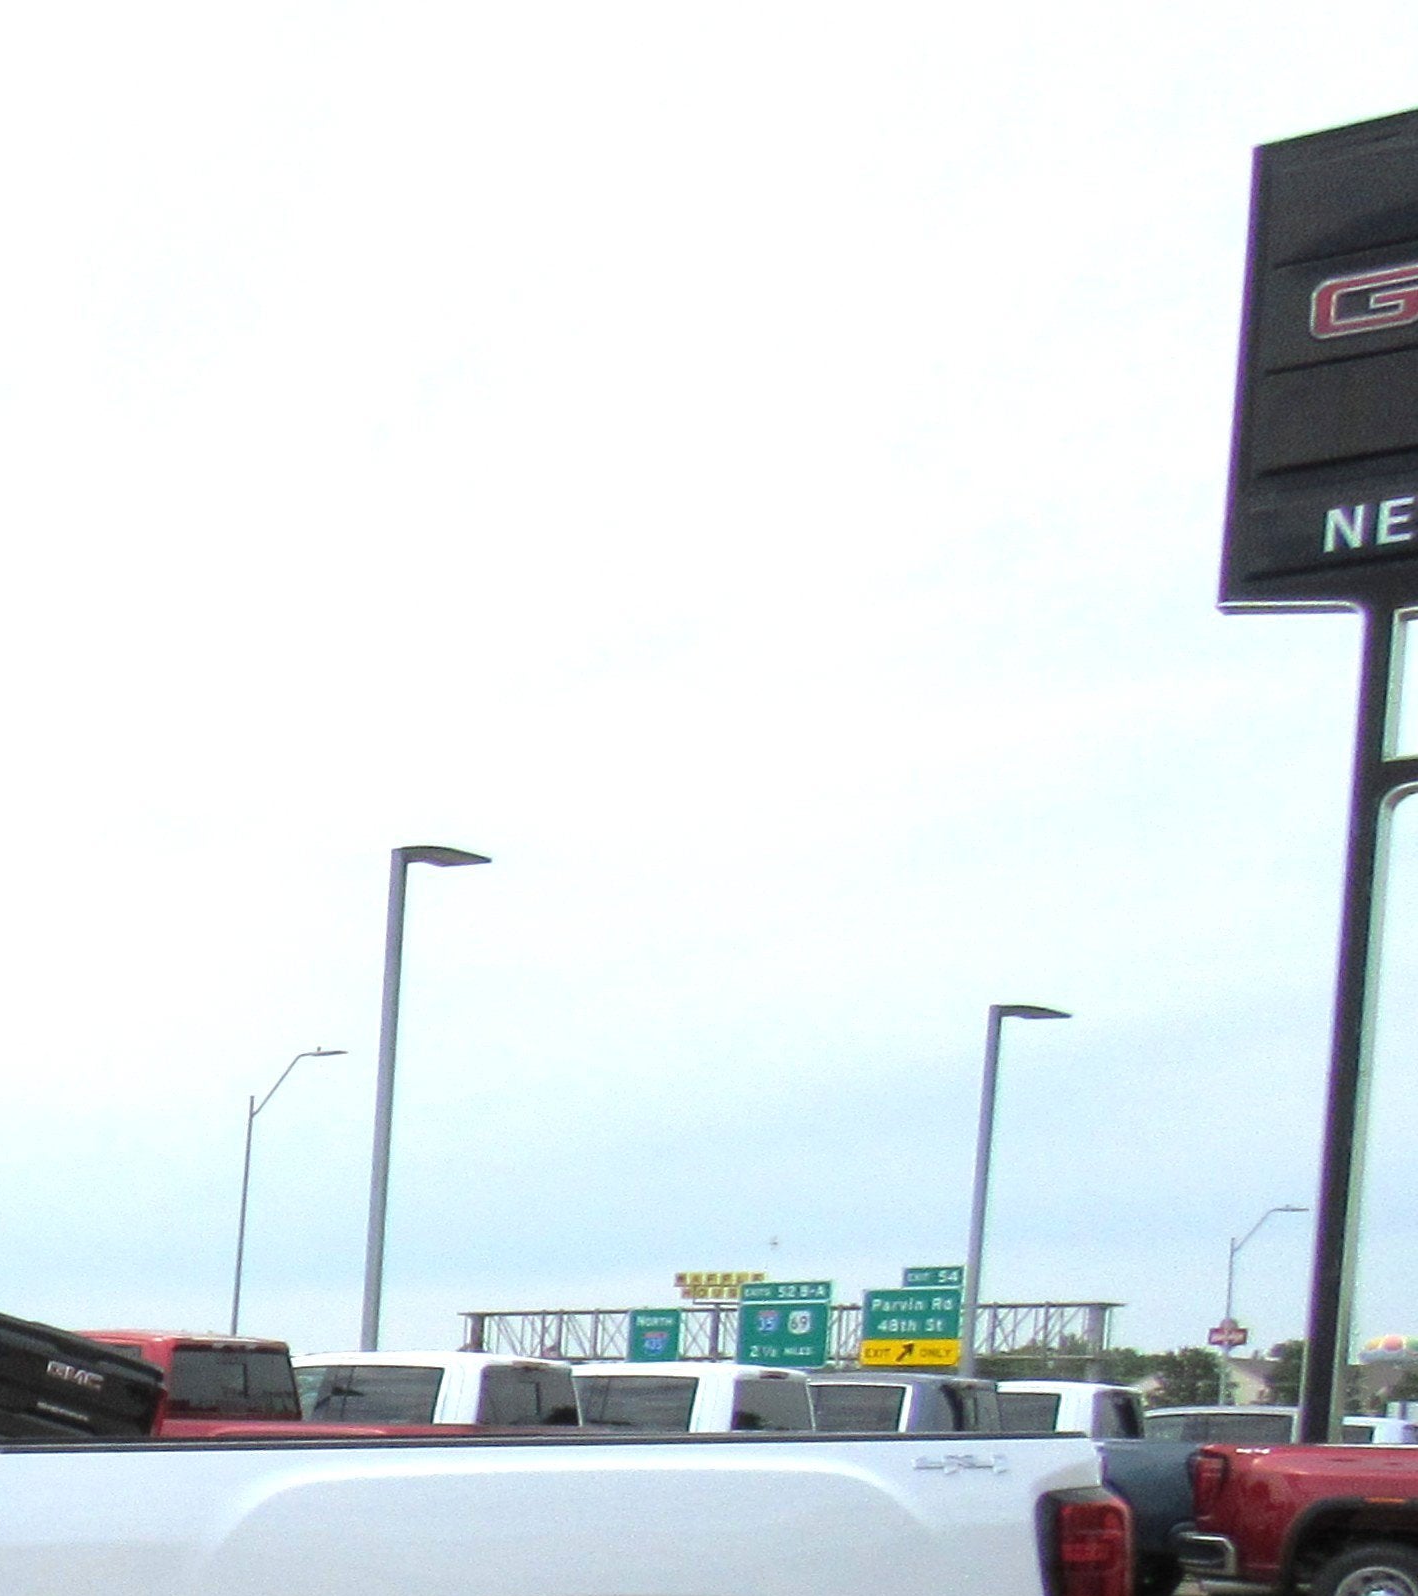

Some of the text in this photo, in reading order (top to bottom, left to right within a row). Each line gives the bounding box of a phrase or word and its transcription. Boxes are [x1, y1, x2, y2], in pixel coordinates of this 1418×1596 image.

[938, 1269, 959, 1283] 54
[871, 1297, 953, 1312] Parvin Rd
[877, 1318, 943, 1332] 48th St
[865, 1348, 892, 1358] EXIT
